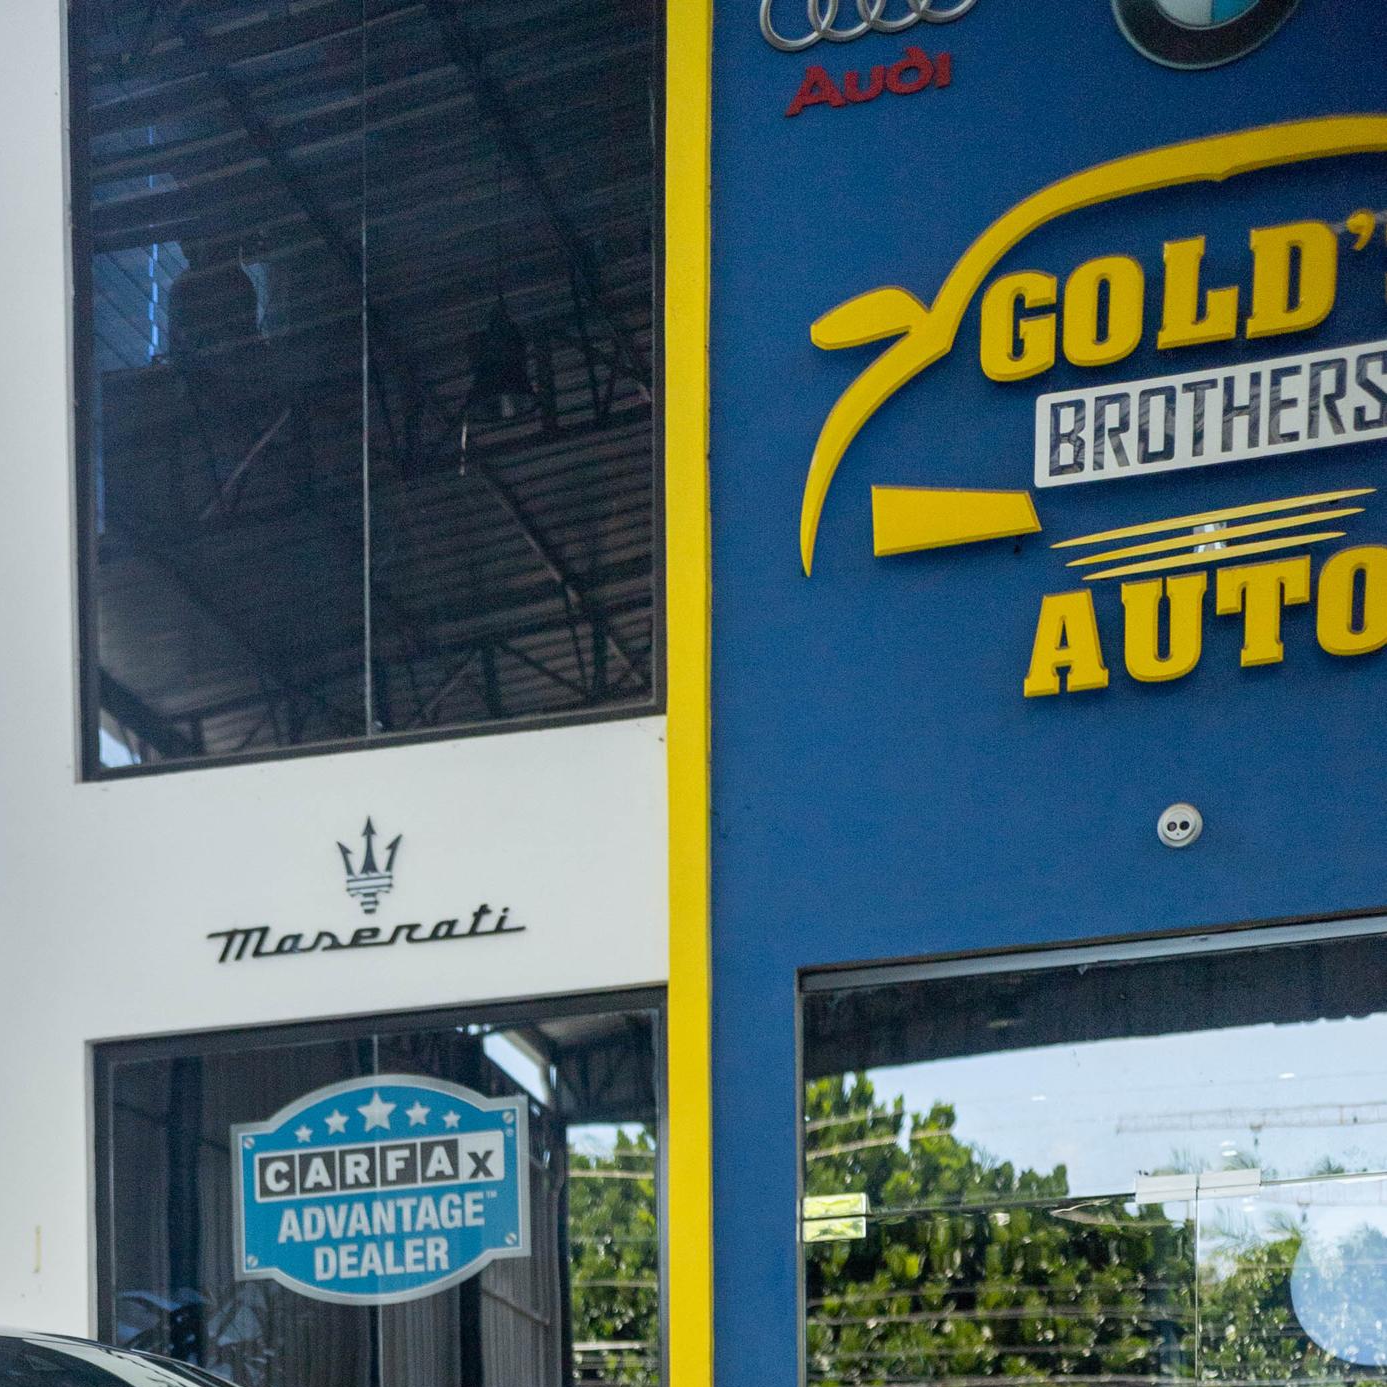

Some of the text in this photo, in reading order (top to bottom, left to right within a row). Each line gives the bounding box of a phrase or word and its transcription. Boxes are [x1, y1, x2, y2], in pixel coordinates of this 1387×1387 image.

[785, 46, 953, 116] Audi
[980, 207, 1387, 382] GOLD'
[1048, 350, 1387, 477] BROTHERS
[1024, 543, 1387, 698] AUTO
[206, 903, 526, 963] Maserati
[262, 1145, 495, 1195] CARFAX
[315, 1236, 450, 1281] DEALER
